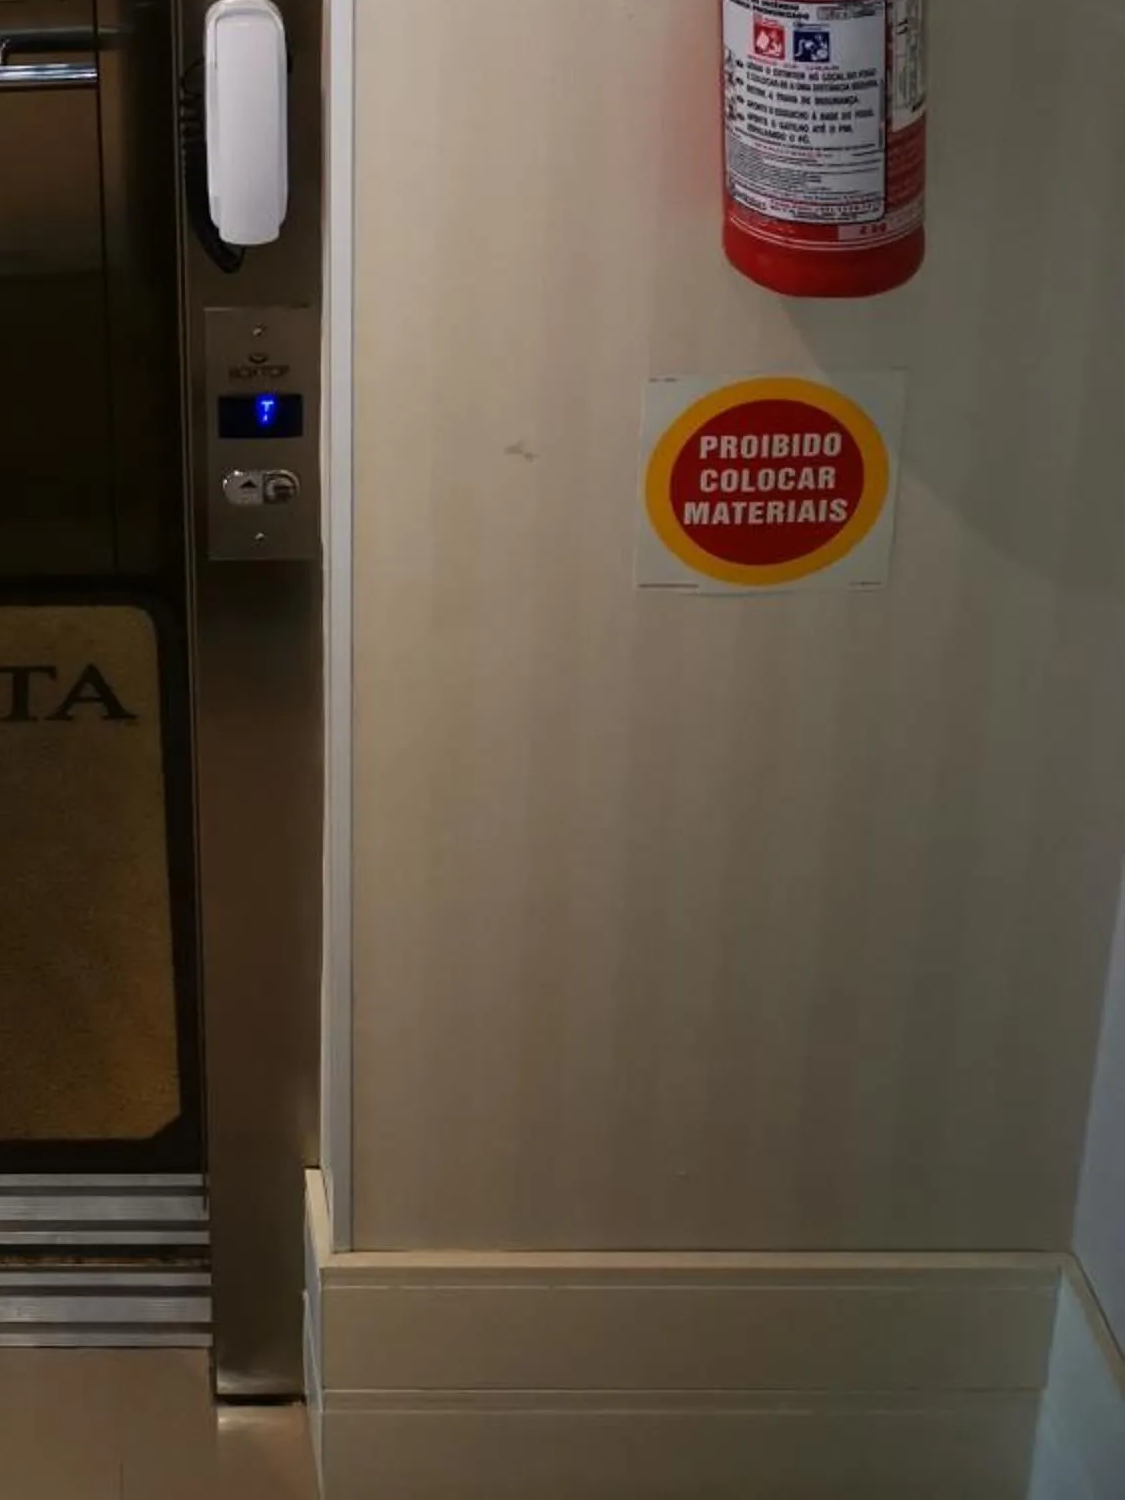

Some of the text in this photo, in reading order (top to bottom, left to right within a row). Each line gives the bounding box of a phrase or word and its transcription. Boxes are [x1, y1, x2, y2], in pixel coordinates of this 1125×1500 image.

[698, 432, 842, 459] PROIBIDO
[699, 466, 836, 493] COLOCAR
[683, 498, 848, 526] MATERIAIS
